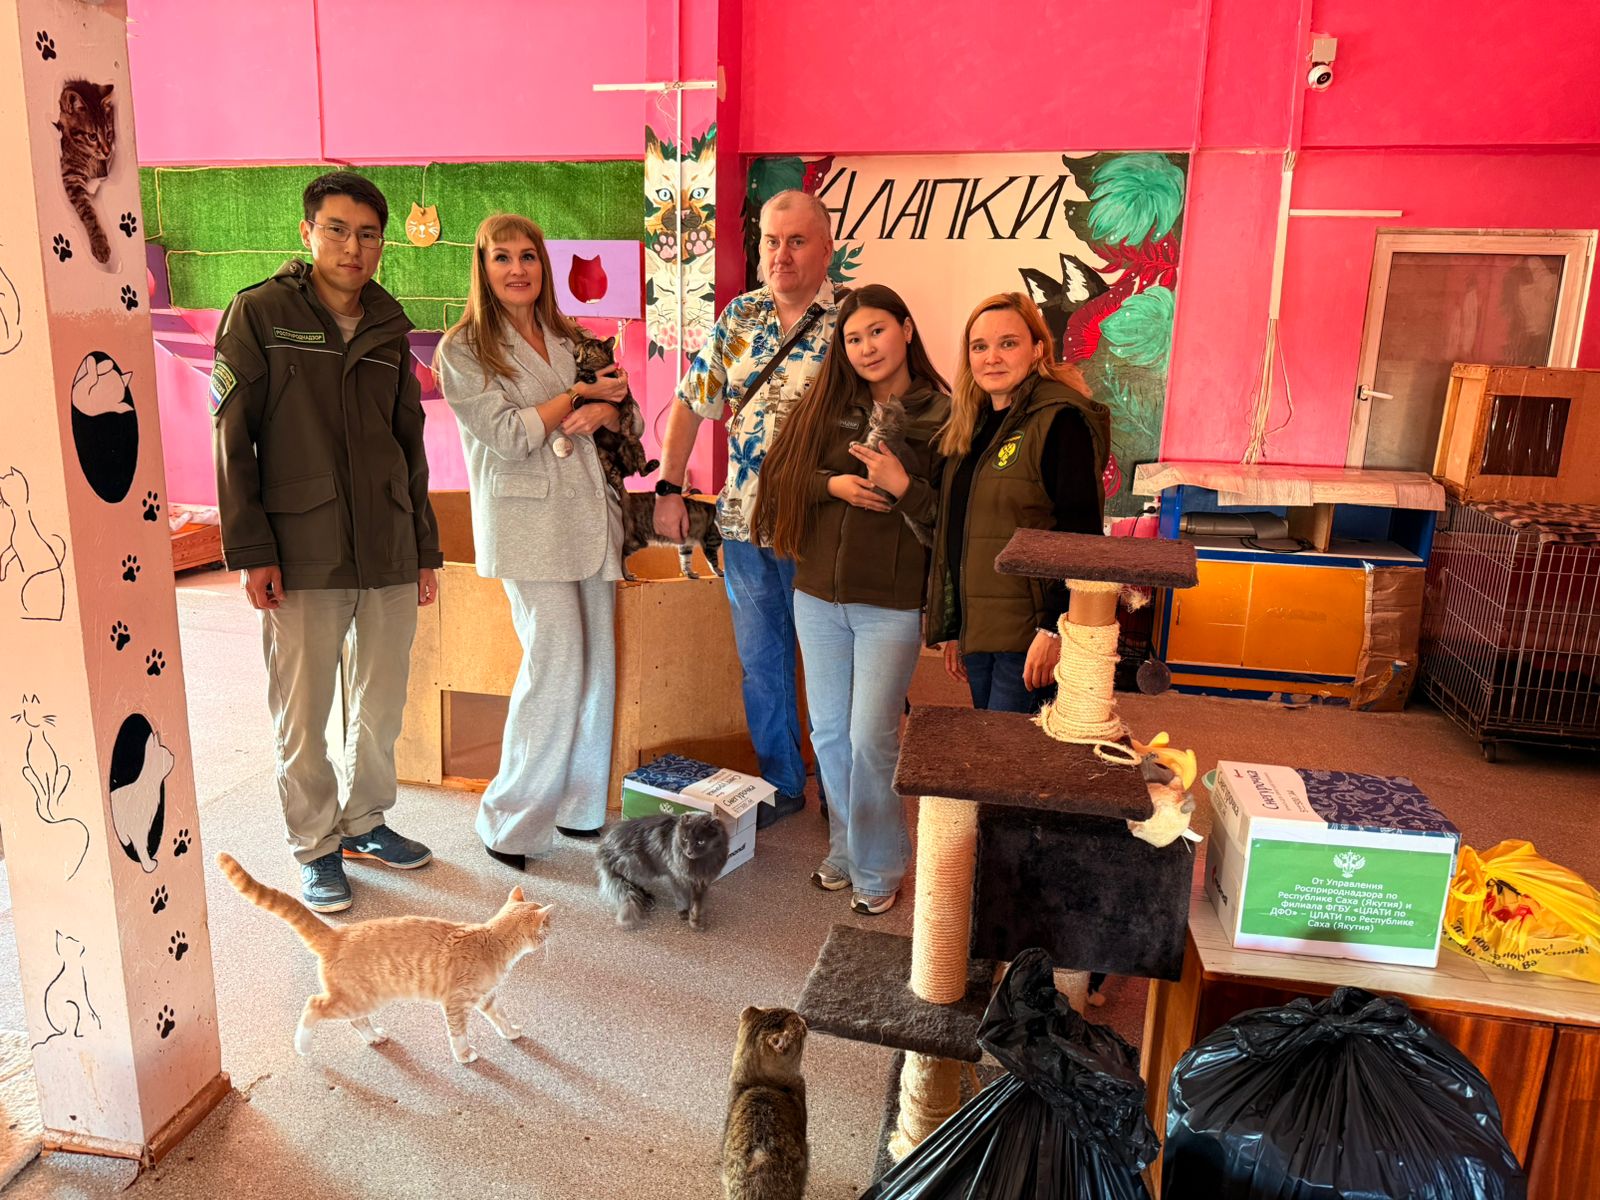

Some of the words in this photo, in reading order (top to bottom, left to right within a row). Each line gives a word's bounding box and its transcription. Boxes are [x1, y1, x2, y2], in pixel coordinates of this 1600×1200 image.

[1295, 884, 1383, 899] Росприроднадзора
[1311, 877, 1324, 885] От
[1326, 878, 1383, 890] Управления
[1278, 892, 1332, 903] Республике
[1335, 897, 1358, 905] Саха
[1361, 899, 1403, 909] (Якутия)
[1281, 900, 1322, 911] филиала
[1326, 904, 1351, 913] ФГБУ
[1353, 907, 1392, 917] «ЦЛАТИ
[1270, 908, 1298, 917] ДФО»
[1309, 911, 1342, 921] ЦЛАТИ
[1359, 915, 1414, 927] Республике
[1307, 920, 1330, 928] Саха
[1333, 923, 1375, 932] (Якутия)
